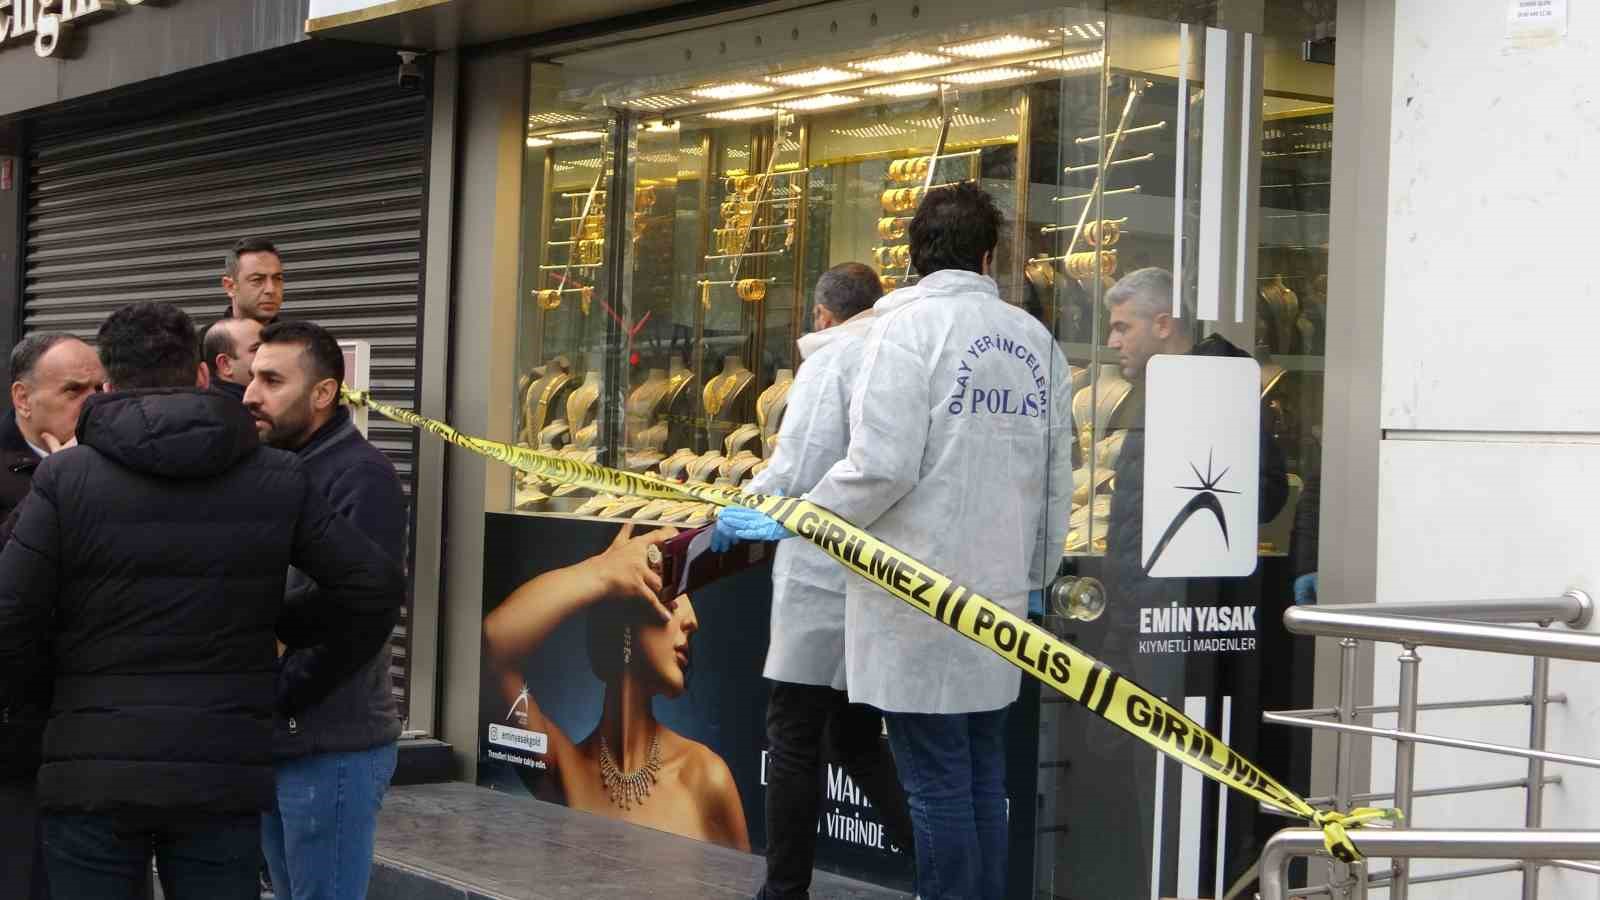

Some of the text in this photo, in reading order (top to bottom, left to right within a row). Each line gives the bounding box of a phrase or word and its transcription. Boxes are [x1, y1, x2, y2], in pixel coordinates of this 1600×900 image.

[949, 360, 972, 415] OLAY
[1140, 601, 1257, 633] EMİN YASAK
[1139, 636, 1257, 653] KIYMETLİ MADENLER
[826, 807, 886, 850] VİTRİNDE
